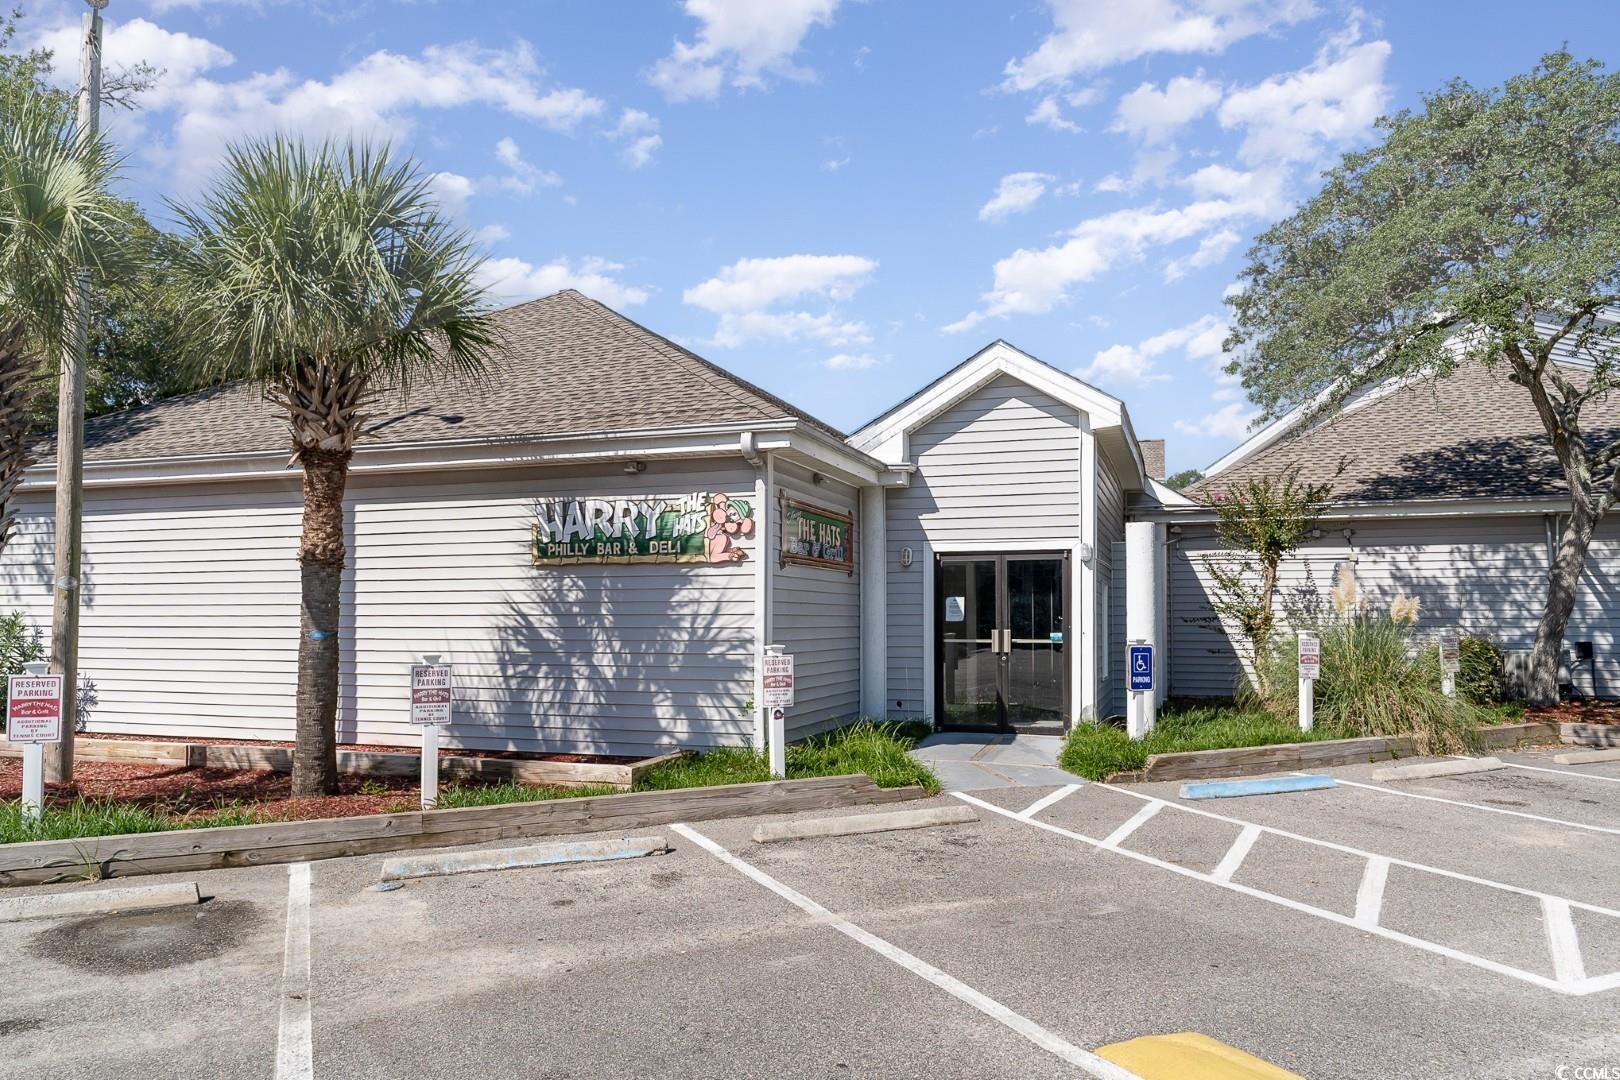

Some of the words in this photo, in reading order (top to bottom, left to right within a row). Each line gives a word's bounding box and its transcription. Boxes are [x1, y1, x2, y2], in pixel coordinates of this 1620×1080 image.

[679, 492, 708, 514] THE
[534, 498, 667, 543] HARRY
[672, 512, 707, 538] HATS
[798, 518, 816, 541] THE
[819, 523, 841, 548] HATS
[548, 543, 589, 556] PHILLY
[597, 541, 621, 555] BAR
[628, 541, 638, 554] &
[650, 540, 681, 554] DELI
[415, 669, 449, 677] RESERVED
[15, 680, 57, 688] RESERVED
[417, 678, 446, 686] PARKING
[17, 689, 54, 697] PARKING
